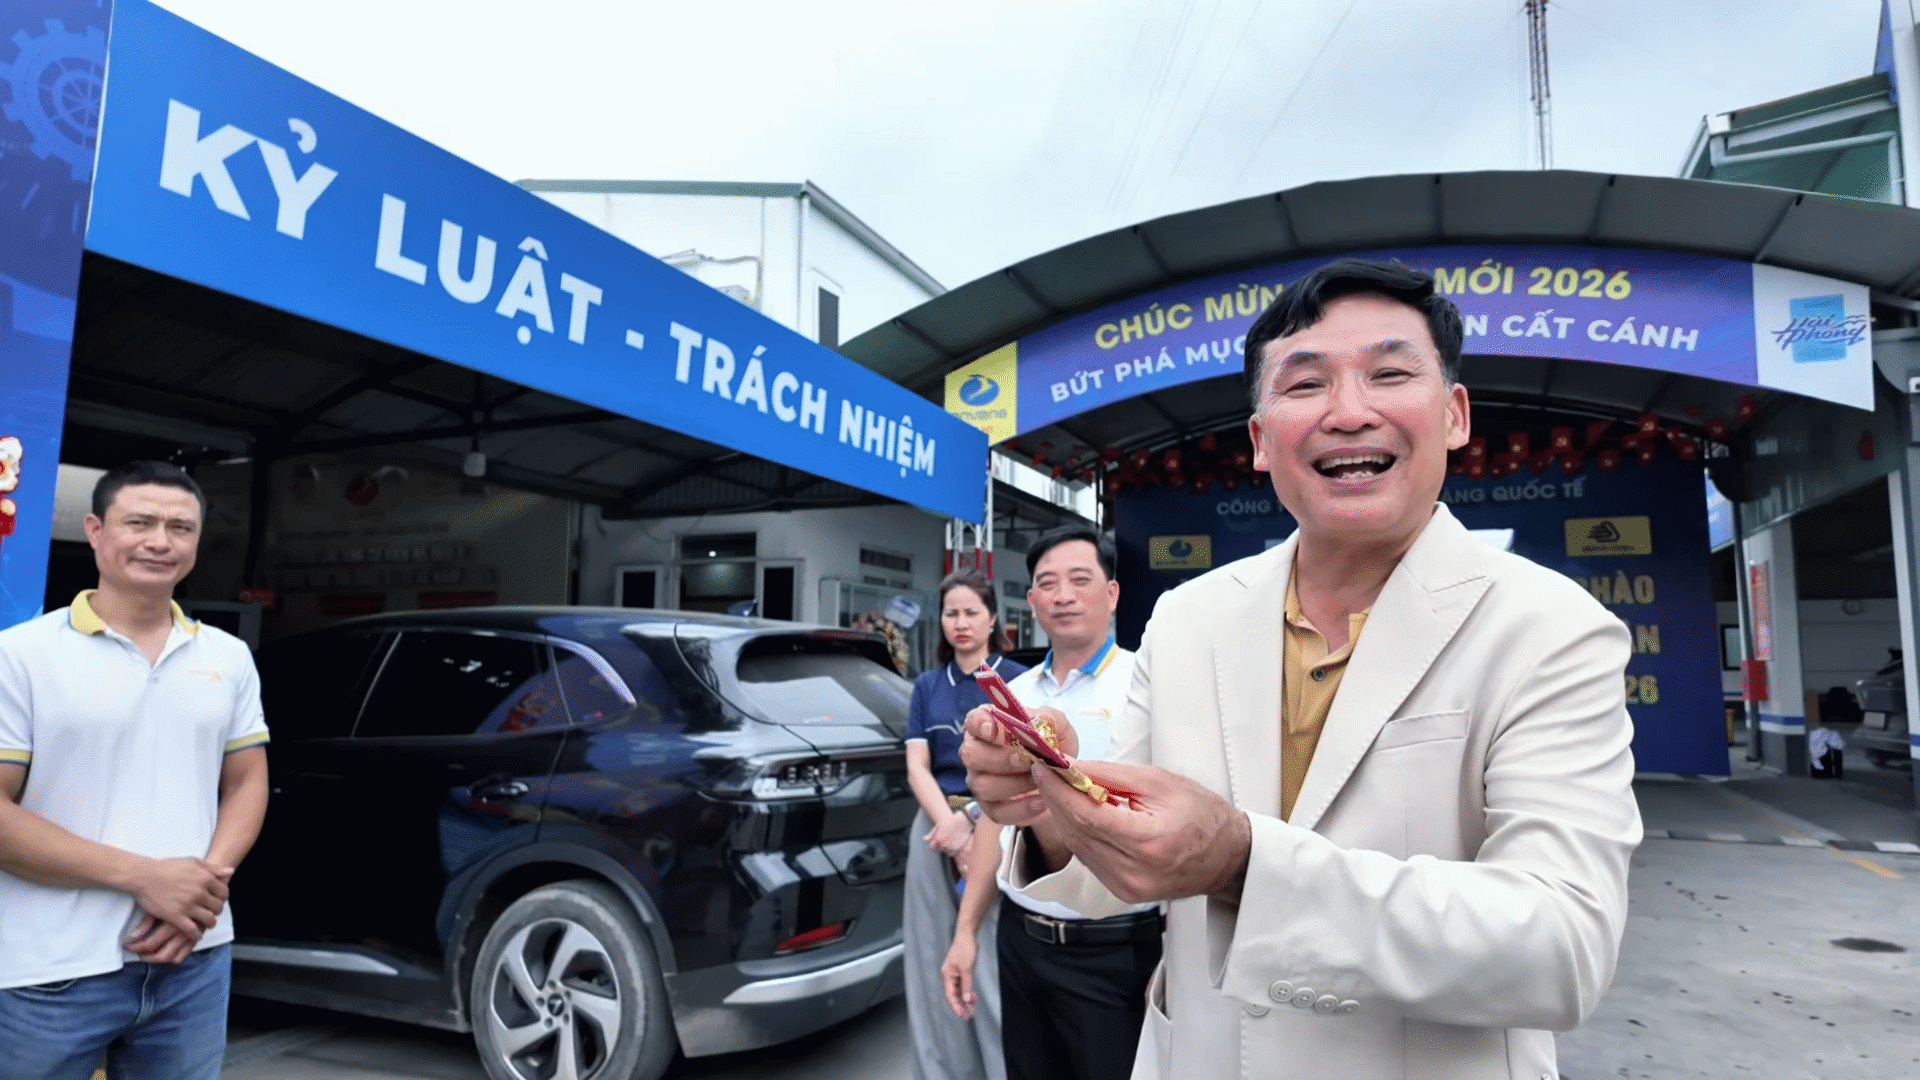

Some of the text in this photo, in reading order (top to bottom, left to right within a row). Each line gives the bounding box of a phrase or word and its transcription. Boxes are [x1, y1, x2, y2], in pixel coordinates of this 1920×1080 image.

[160, 98, 339, 241] KỶ
[375, 193, 603, 345] LUẬT
[670, 321, 827, 434] TRÁCH
[839, 399, 936, 478] NHIỆM
[1094, 258, 1632, 349] CHÚC MỪN MỚI 2026
[1050, 308, 1699, 402] BỨT PHÁ MỤC N CẤT CÁNH
[1216, 498, 1272, 516] CÔNG
[1492, 478, 1556, 502] QUỐC
[1562, 475, 1588, 498] TẾ
[1576, 569, 1656, 605] HÀO
